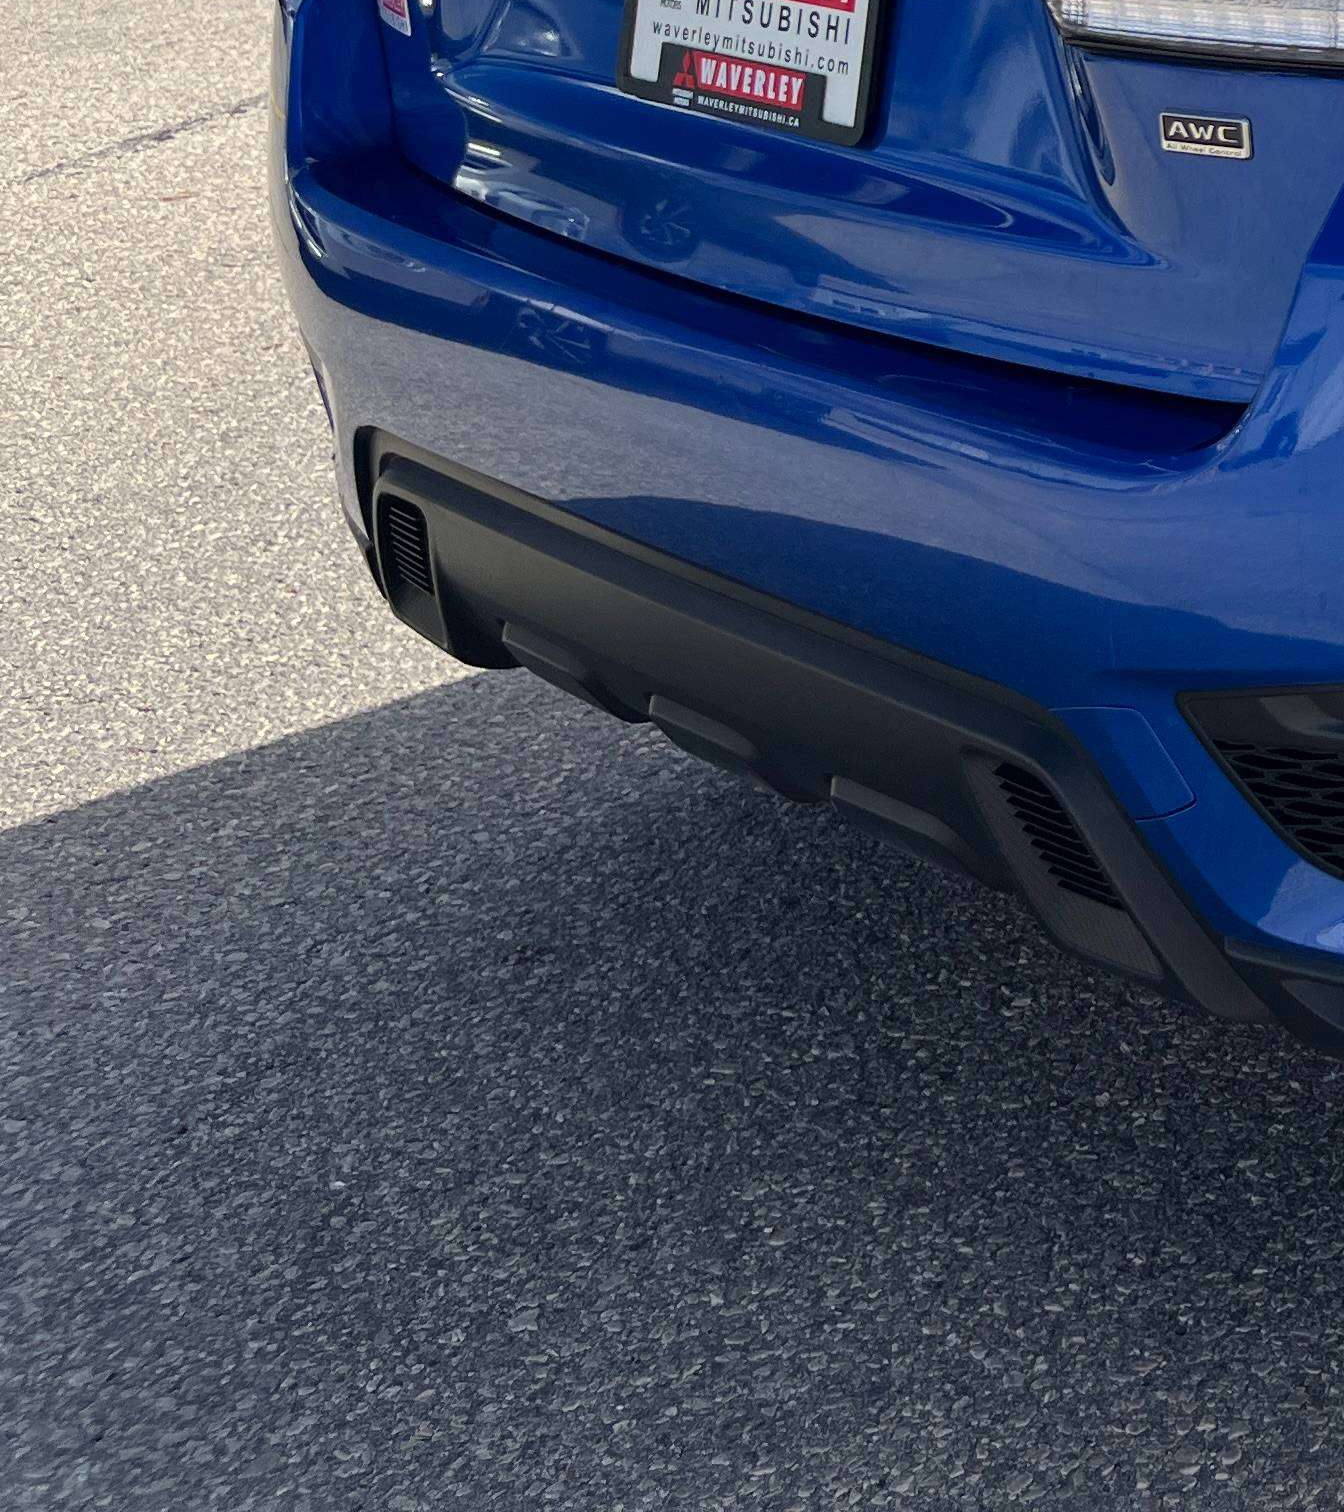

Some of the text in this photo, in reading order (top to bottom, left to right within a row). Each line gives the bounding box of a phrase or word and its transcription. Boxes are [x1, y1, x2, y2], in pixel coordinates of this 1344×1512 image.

[652, 20, 850, 75] waverleymitsubishi.com
[700, 57, 804, 105] WAVERLEY
[697, 95, 800, 128] WAVERLEYMITSUBISHI.CA
[1168, 120, 1239, 144] AWC
